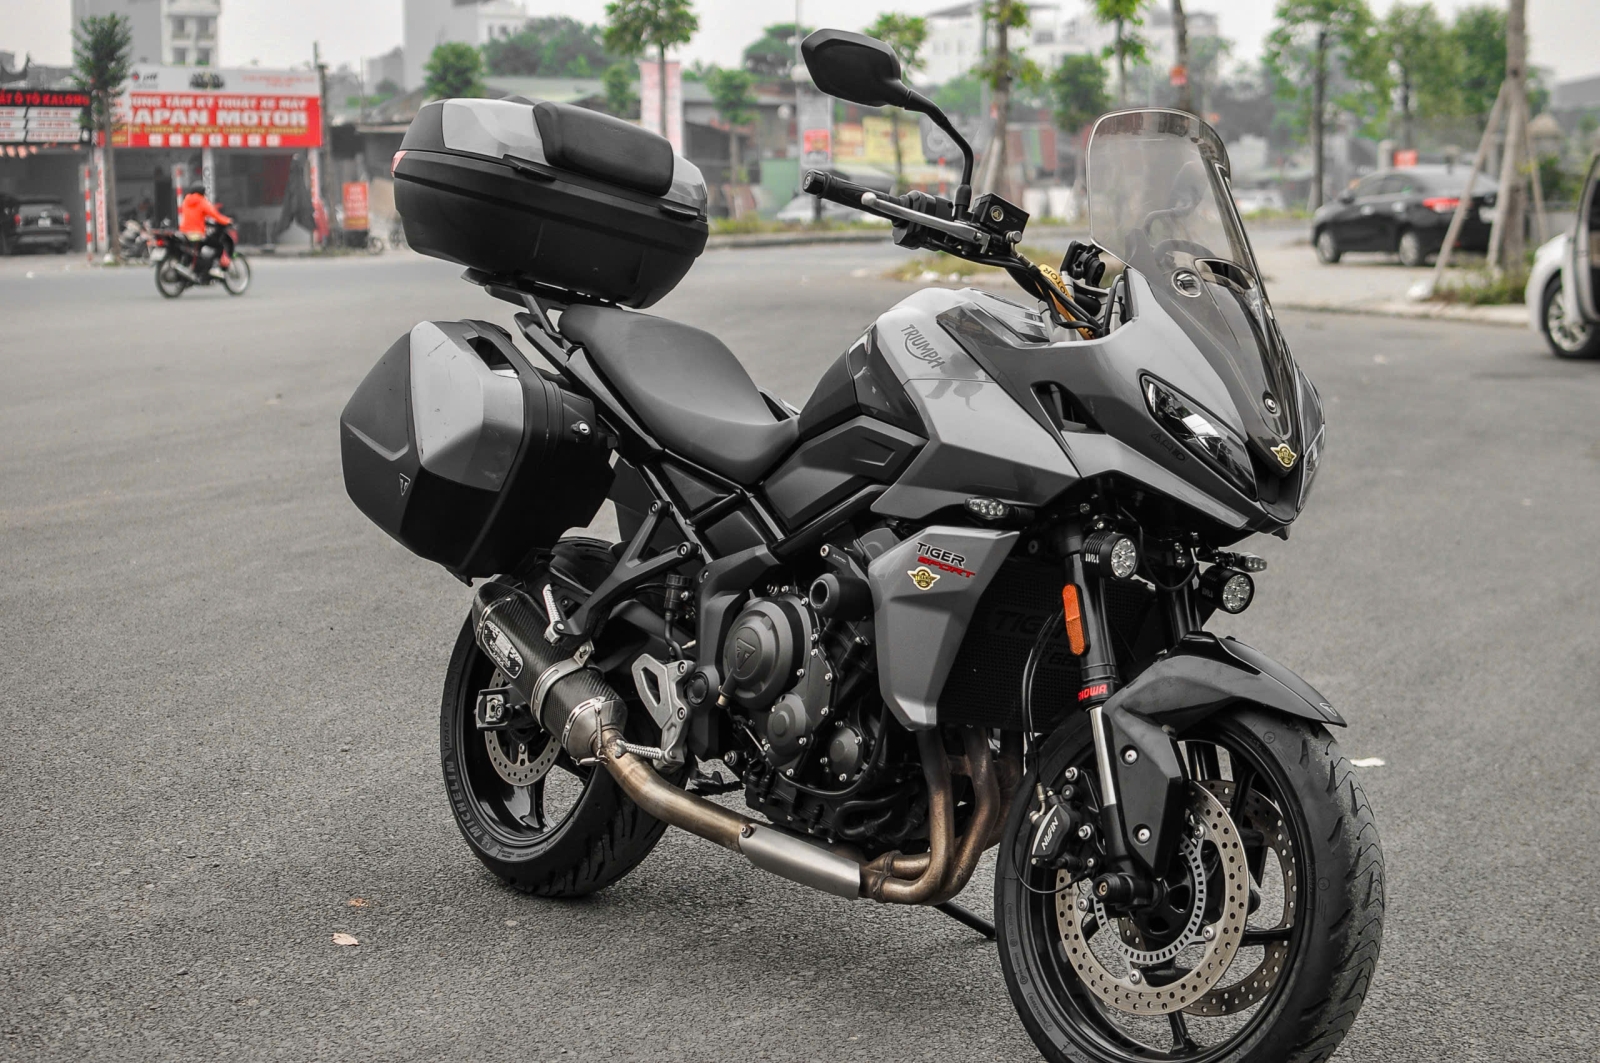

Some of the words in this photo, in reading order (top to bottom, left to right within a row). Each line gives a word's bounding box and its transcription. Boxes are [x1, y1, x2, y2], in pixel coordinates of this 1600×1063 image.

[216, 110, 307, 127] MOTOR
[901, 324, 945, 369] TRIUMPH
[917, 541, 966, 568] TIGER
[917, 555, 976, 578] SPORT
[446, 760, 482, 838] MICHELIN
